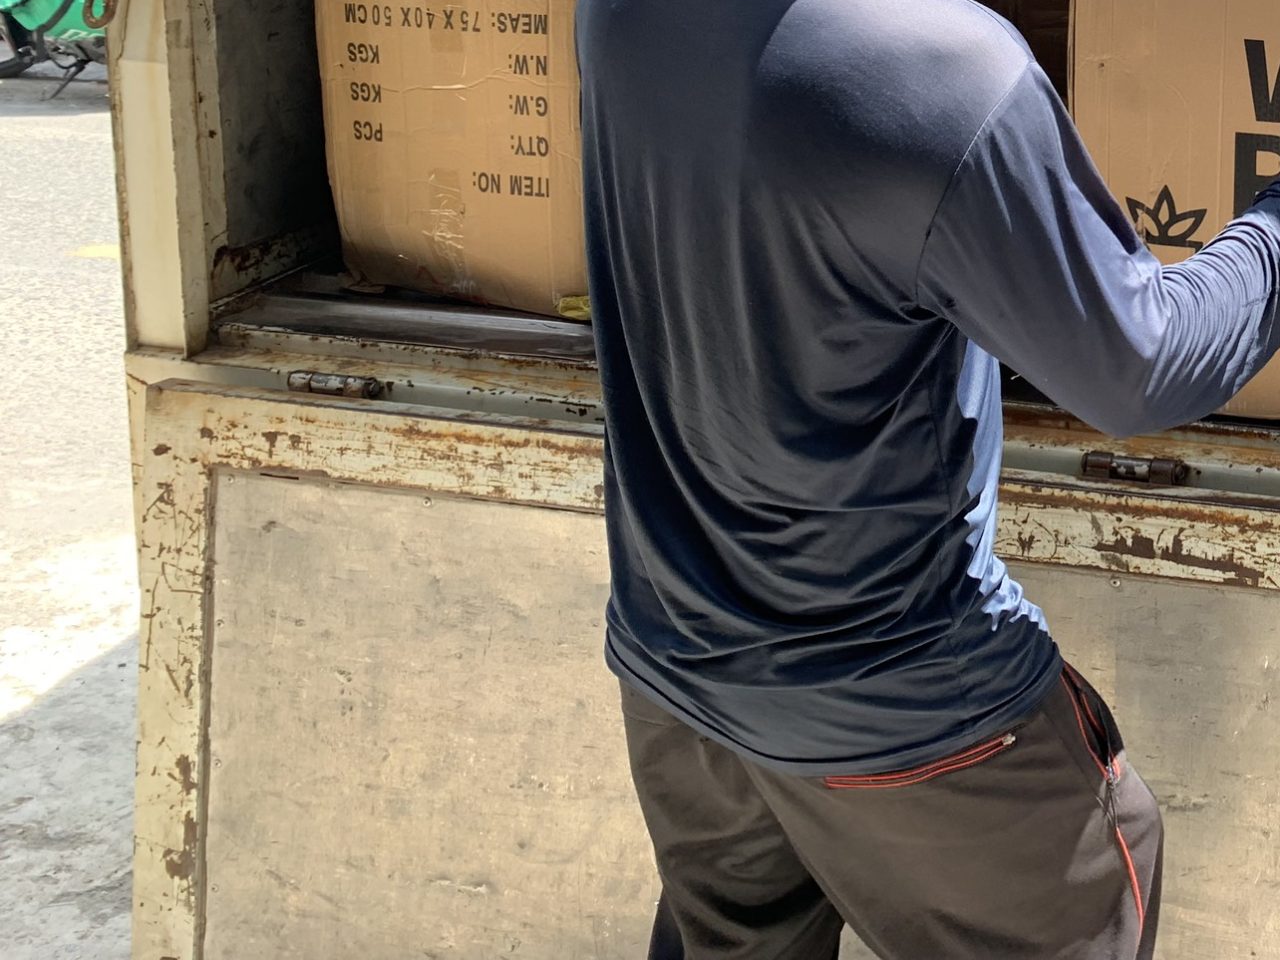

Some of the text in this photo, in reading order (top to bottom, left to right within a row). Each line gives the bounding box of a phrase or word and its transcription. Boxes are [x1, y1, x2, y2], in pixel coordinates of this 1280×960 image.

[491, 12, 548, 35] MEAS:
[347, 42, 380, 64] KGS
[508, 54, 548, 76] N.W:
[350, 81, 382, 103] KGS
[509, 94, 548, 116] G.W:
[353, 120, 383, 141] PCS
[510, 135, 549, 157] QTY:
[473, 171, 549, 197] ITEM NO:
